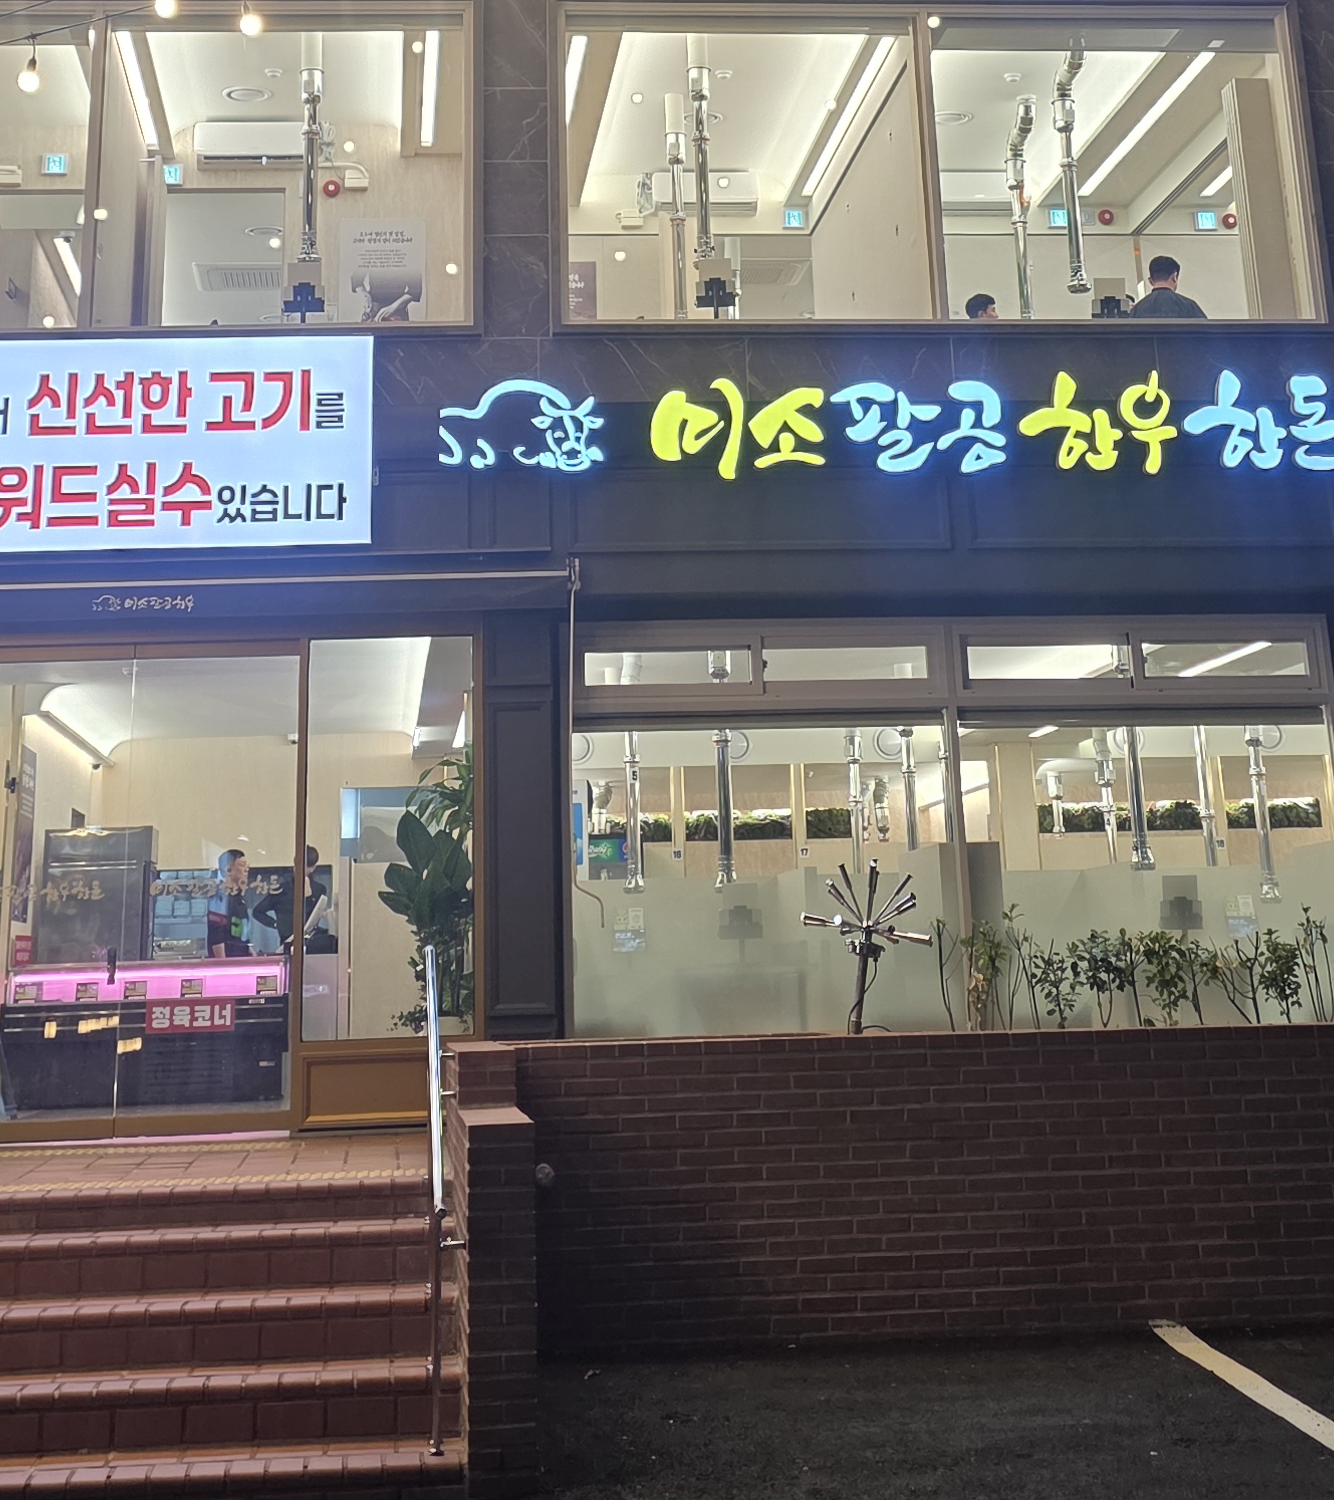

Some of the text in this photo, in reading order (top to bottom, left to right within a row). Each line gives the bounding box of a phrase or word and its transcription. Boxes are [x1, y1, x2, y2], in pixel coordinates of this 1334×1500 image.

[25, 369, 194, 437] 신선한
[204, 368, 346, 433] 고기를
[151, 1003, 233, 1029] 정육코너
